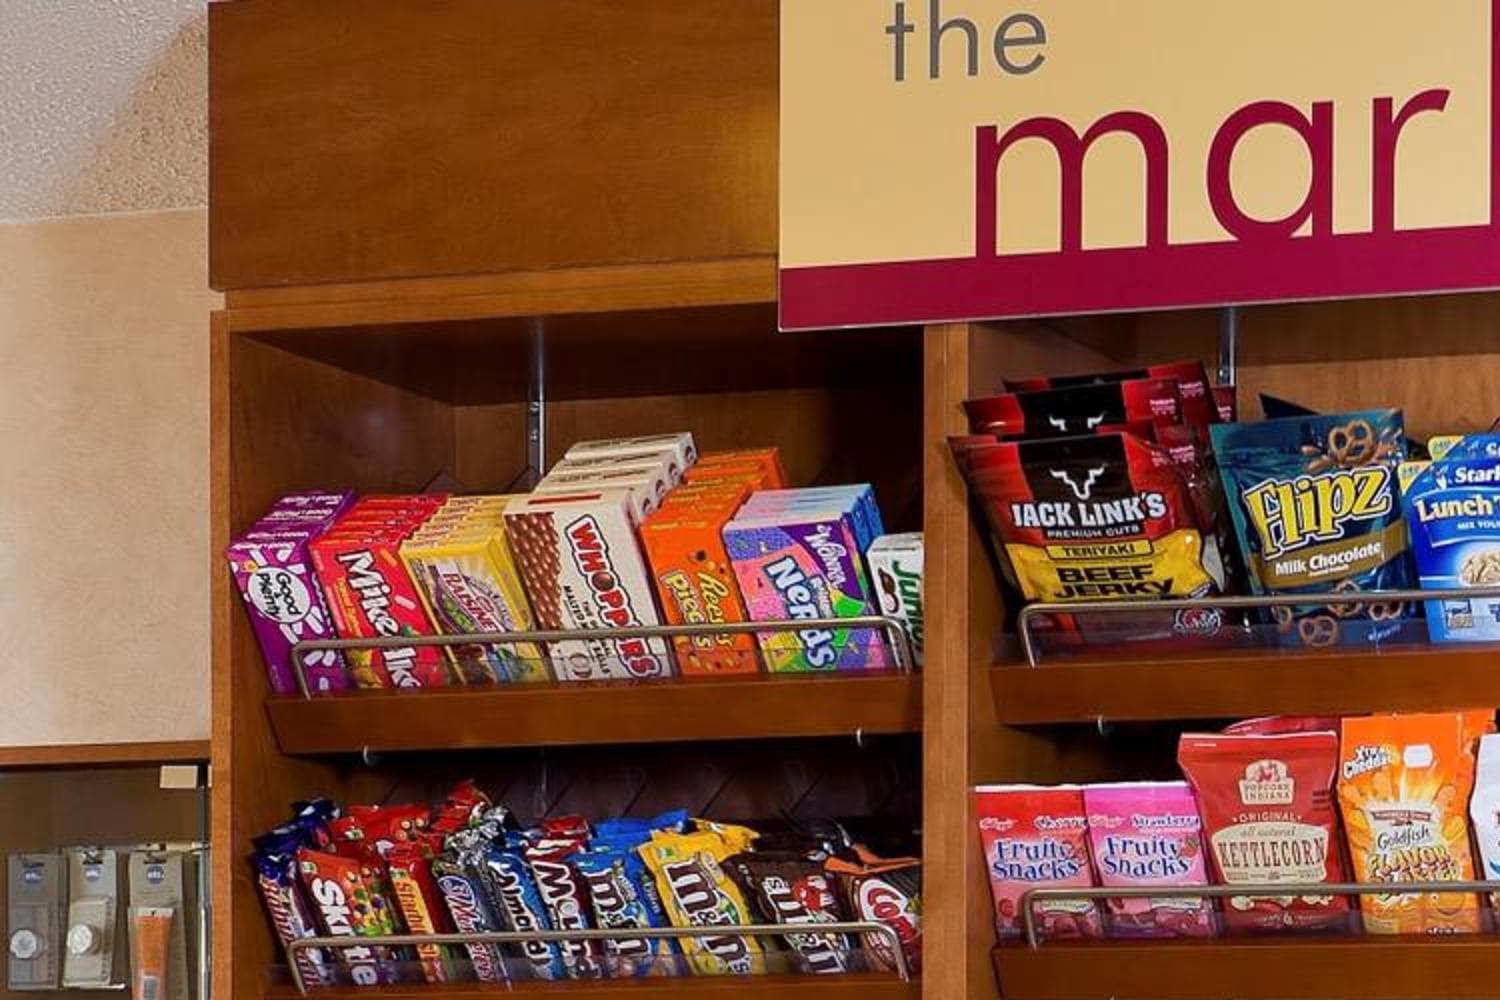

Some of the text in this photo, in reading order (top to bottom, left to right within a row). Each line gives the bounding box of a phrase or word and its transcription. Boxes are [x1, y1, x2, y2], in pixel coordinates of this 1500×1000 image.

[885, 0, 1048, 82] the
[1011, 492, 1167, 529] JACK LINK'S
[1245, 468, 1391, 557] Flipz
[1416, 493, 1495, 523] Lunch
[1055, 564, 1153, 584] BEEF
[1274, 560, 1308, 577] Milk
[1308, 541, 1383, 570] Chocolate
[336, 550, 400, 637] Mike
[570, 520, 656, 675] WHOPPRS
[1217, 836, 1326, 869] KETTLECORN
[1376, 826, 1433, 850] Goldfish
[992, 857, 1081, 881] Snacks
[1103, 855, 1191, 878] Snacks
